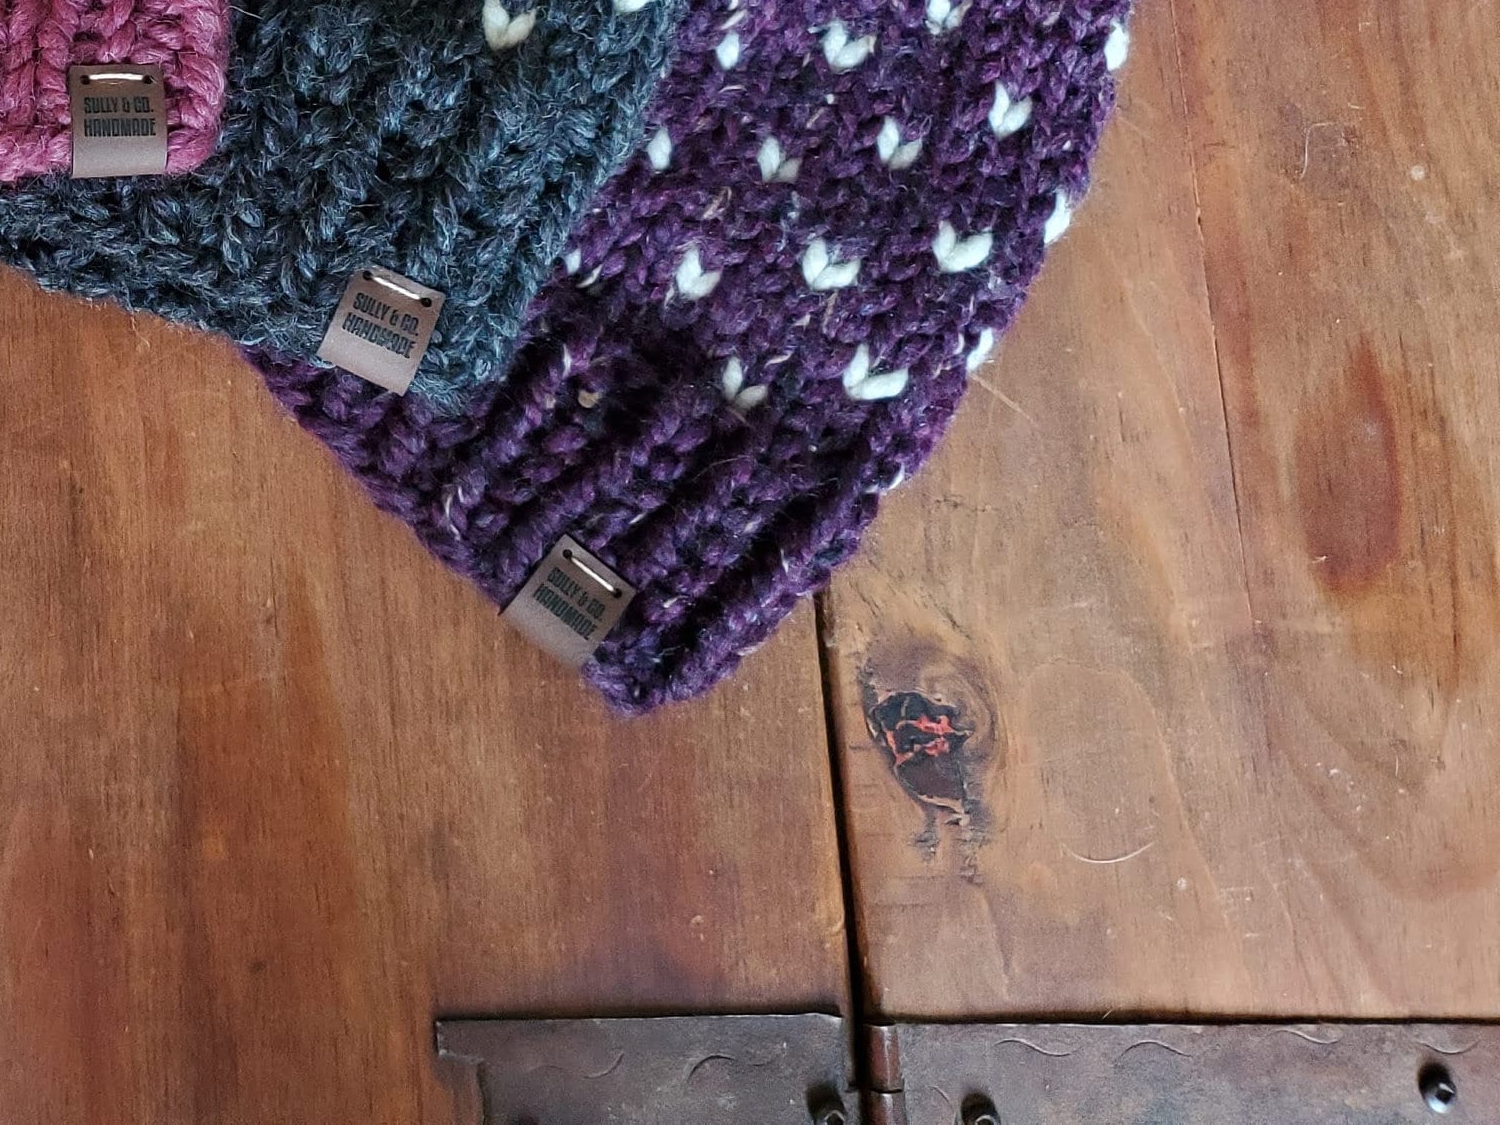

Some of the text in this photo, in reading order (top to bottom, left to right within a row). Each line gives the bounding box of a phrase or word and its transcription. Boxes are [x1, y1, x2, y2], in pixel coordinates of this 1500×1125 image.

[83, 96, 155, 114] SULLY & CO.
[83, 118, 156, 137] HANDMADE
[353, 292, 391, 321] SULLY
[389, 309, 399, 326] &
[341, 312, 417, 359] HANDMADE
